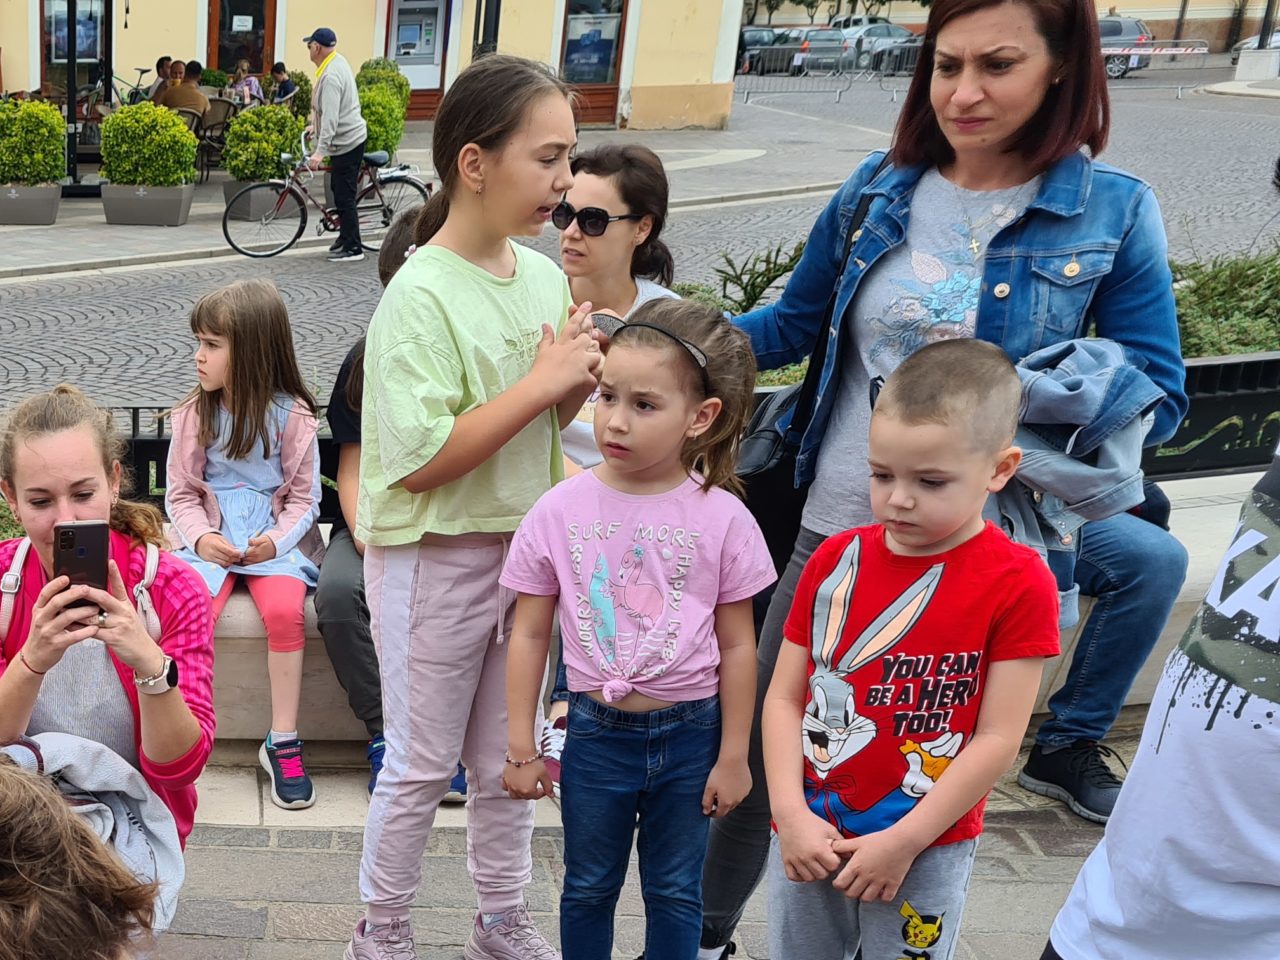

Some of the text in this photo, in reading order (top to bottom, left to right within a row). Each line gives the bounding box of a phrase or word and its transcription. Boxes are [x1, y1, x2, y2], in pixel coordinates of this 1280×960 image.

[568, 519, 700, 551] SURF MORE
[667, 554, 693, 612] HAPPY
[575, 592, 595, 658] WORRY
[881, 650, 983, 684] YOU CAN
[864, 673, 980, 711] BE A HERO
[893, 709, 954, 737] TOO!
